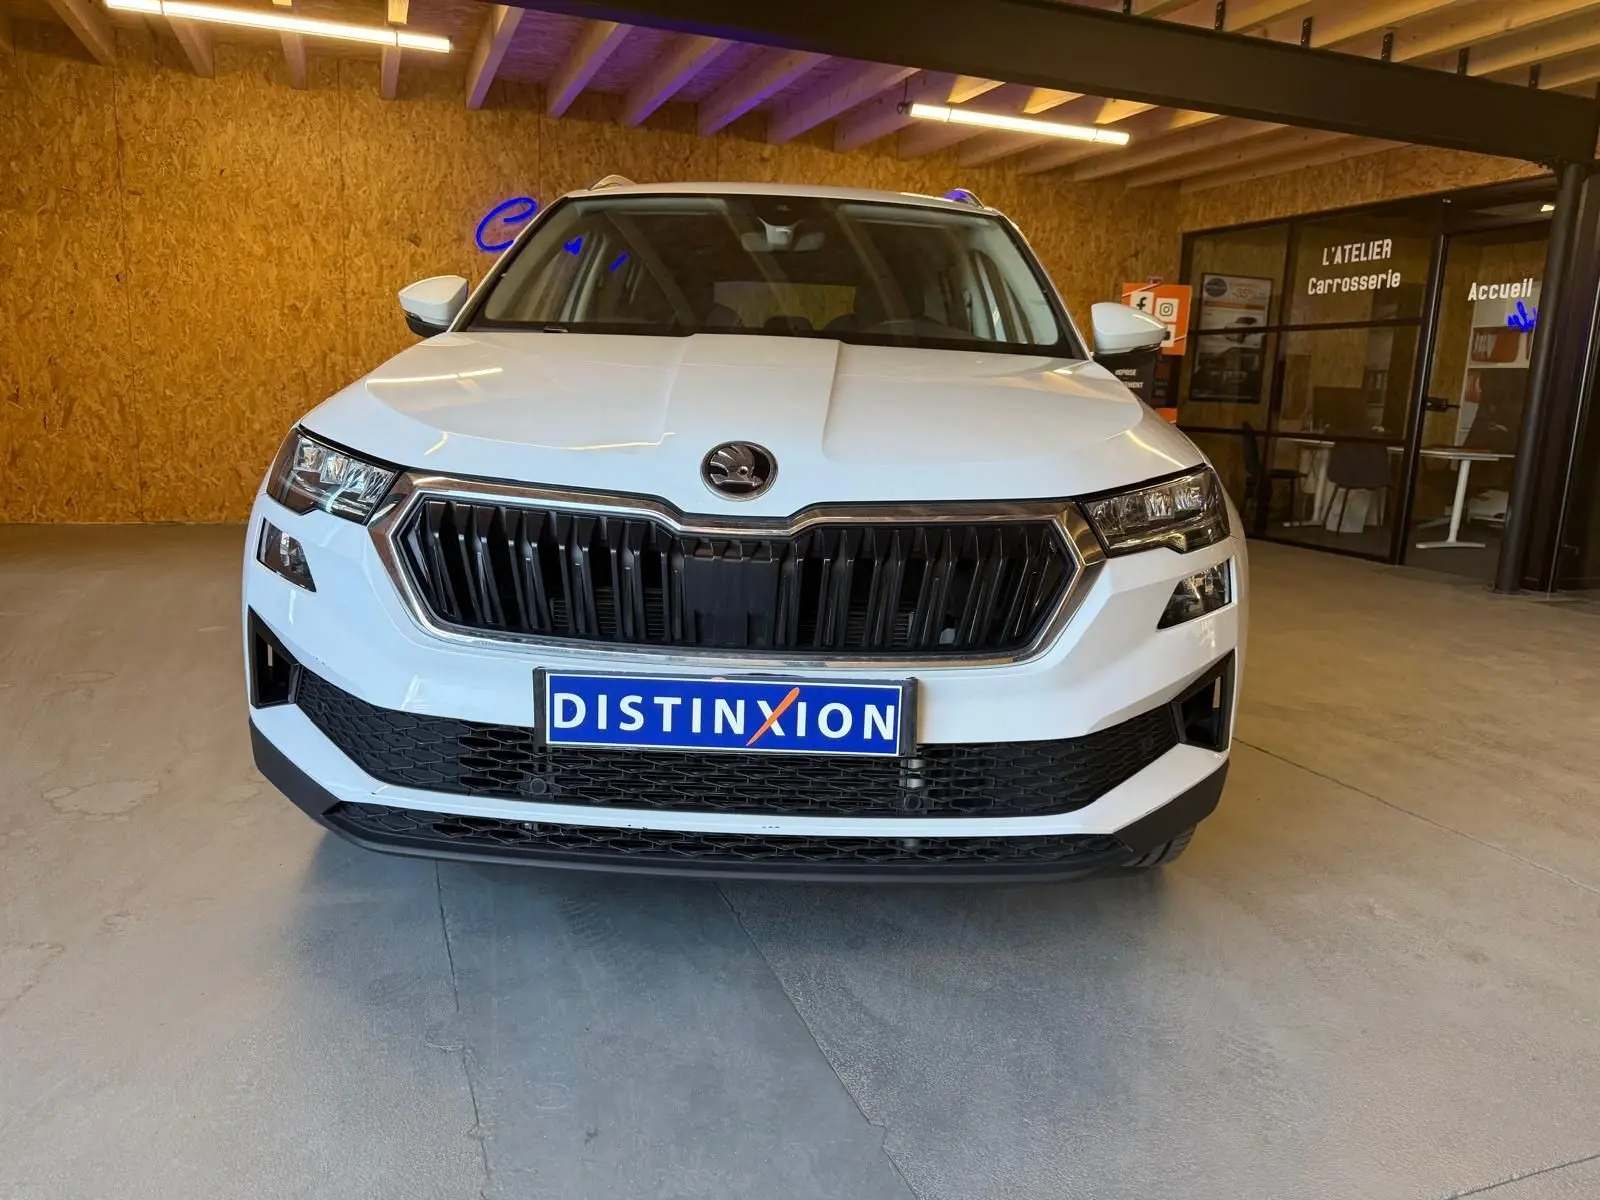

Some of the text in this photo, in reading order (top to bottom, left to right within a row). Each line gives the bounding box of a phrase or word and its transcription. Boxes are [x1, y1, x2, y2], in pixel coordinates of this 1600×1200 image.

[1322, 238, 1393, 266] L'ATELIER
[1307, 269, 1401, 296] Carrosserie
[1467, 278, 1534, 302] Accueil
[553, 687, 896, 747] DISTINXION
